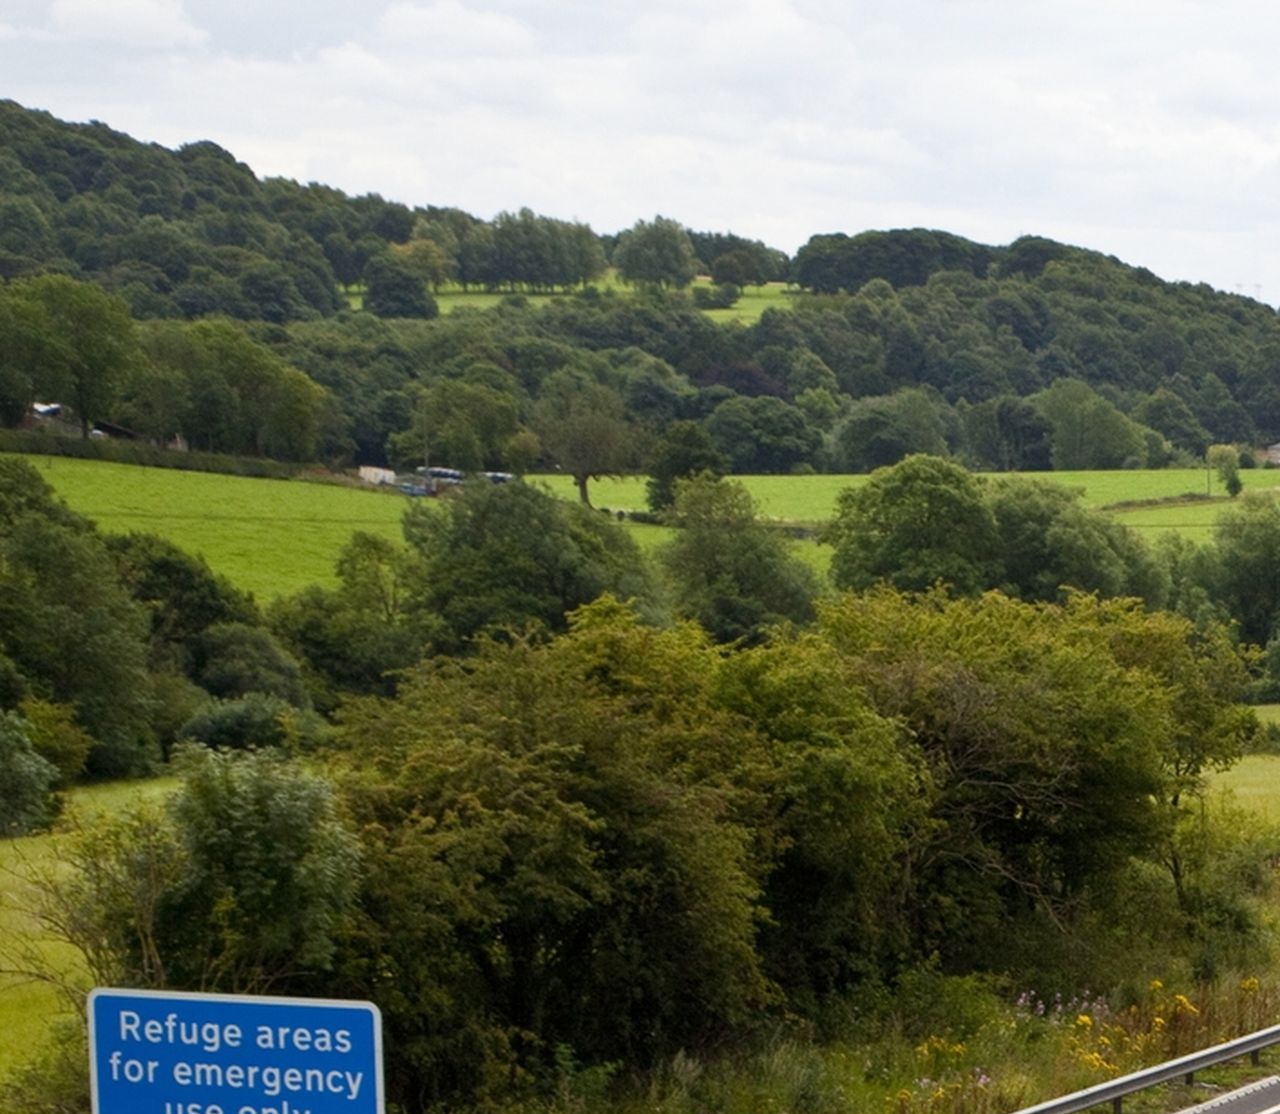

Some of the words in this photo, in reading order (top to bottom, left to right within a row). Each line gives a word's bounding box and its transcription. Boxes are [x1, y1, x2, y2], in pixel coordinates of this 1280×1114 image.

[119, 1011, 242, 1052] Refuge
[256, 1025, 352, 1053] areas
[109, 1052, 159, 1083] for
[173, 1061, 363, 1100] emergency
